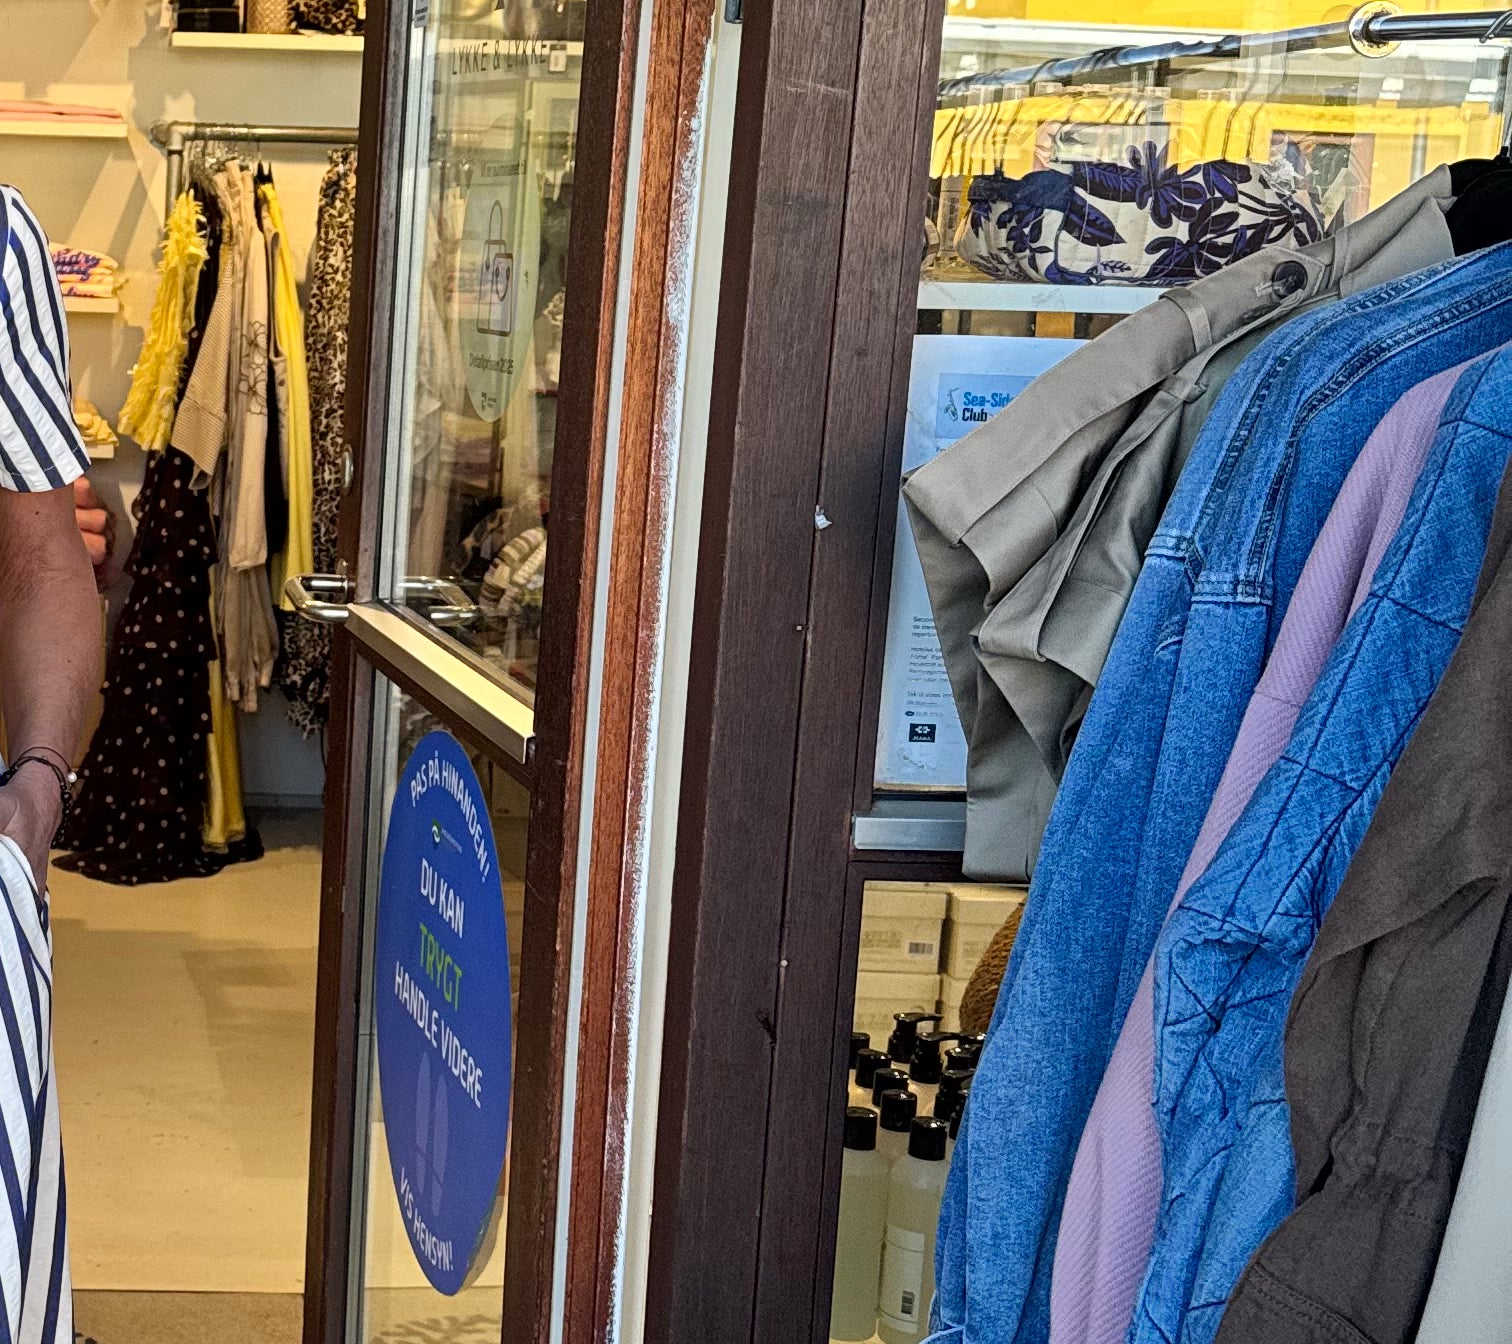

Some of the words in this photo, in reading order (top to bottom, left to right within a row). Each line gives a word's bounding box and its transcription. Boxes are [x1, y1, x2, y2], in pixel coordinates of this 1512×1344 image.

[452, 42, 488, 75] LYKKE
[493, 40, 500, 71] &
[506, 35, 548, 69] LYKKE
[961, 408, 988, 422] Club
[410, 770, 428, 809] PAS
[426, 750, 440, 789] PÅ
[441, 757, 491, 884] HINANDEN!
[421, 858, 437, 903] DU
[438, 877, 465, 939] KAN
[419, 922, 463, 1012] TRYGT
[394, 960, 439, 1051] HANDLE
[440, 1024, 483, 1110] VIDERE
[399, 1166, 414, 1215] VIS
[412, 1202, 454, 1274] HENSYN!
